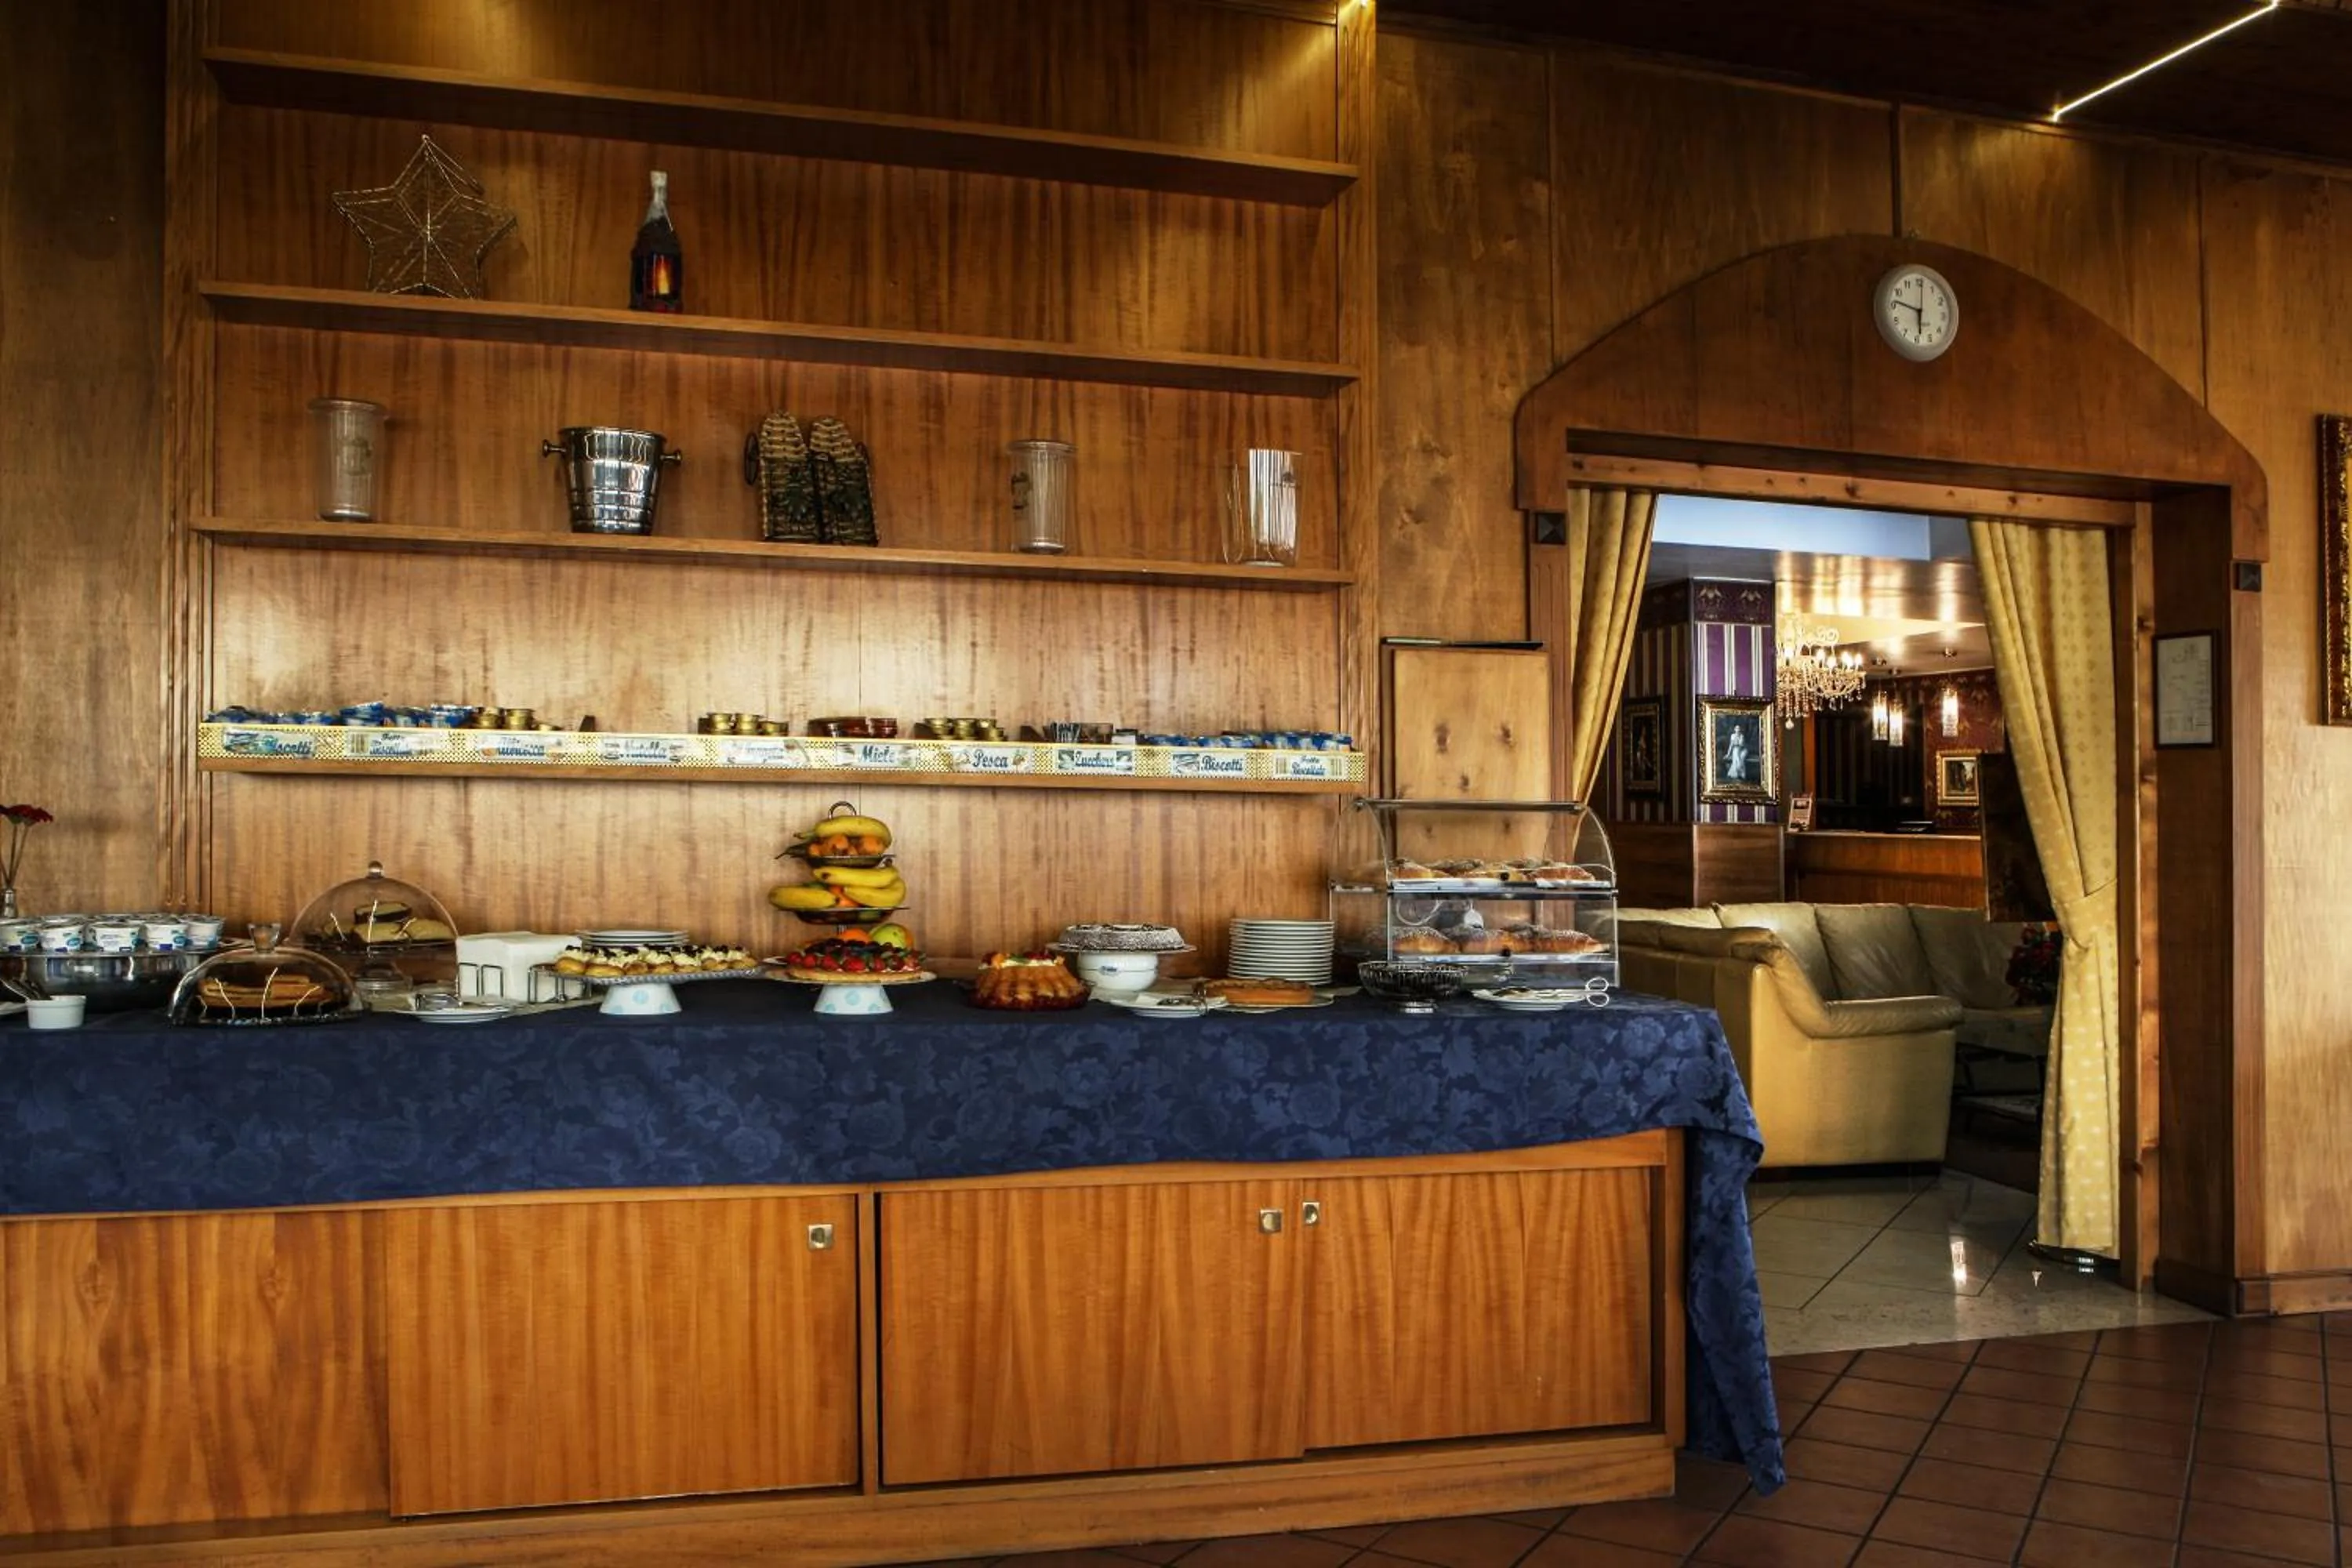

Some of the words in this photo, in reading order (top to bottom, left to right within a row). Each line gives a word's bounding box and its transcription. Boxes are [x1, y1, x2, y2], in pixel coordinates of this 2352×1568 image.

[1904, 280, 1911, 289] 11
[1937, 296, 1944, 307] 2
[859, 746, 895, 762] Miele
[973, 749, 1008, 768] Pesca
[1201, 755, 1243, 771] Biscotti
